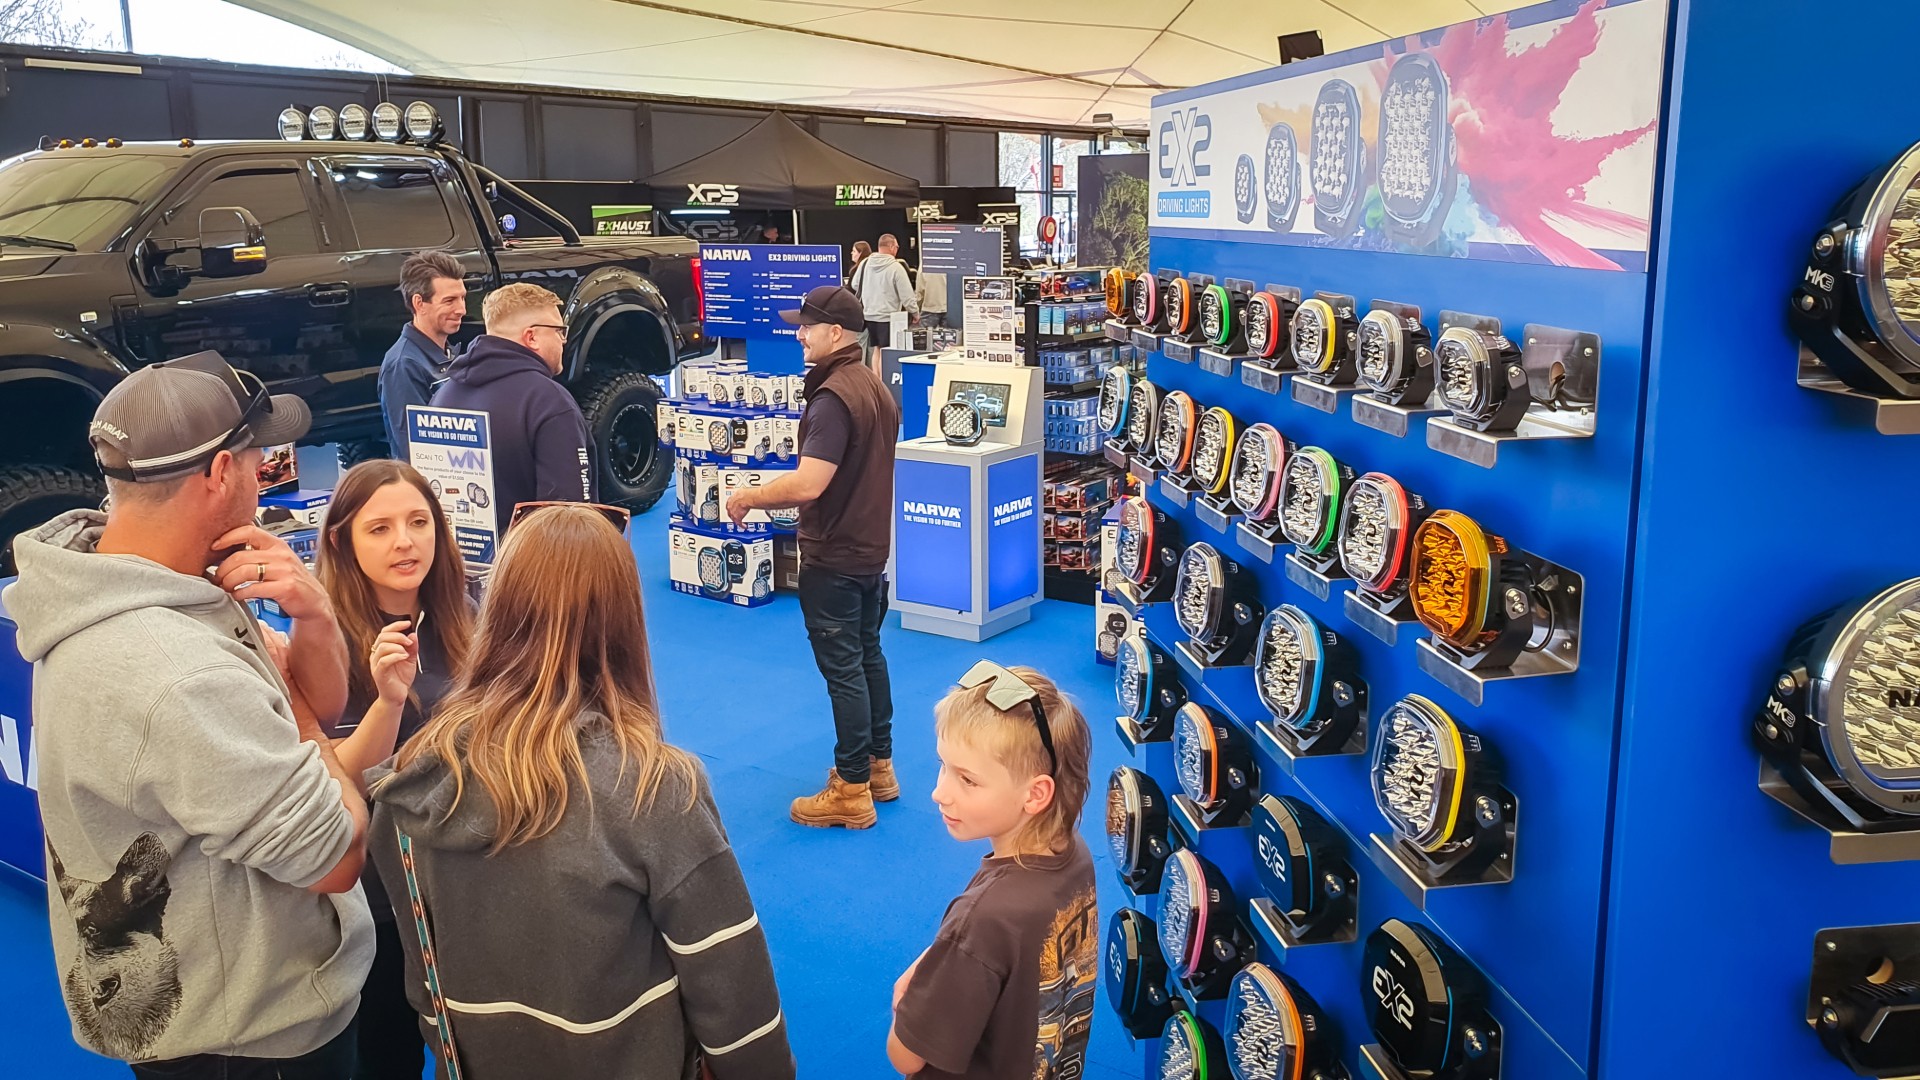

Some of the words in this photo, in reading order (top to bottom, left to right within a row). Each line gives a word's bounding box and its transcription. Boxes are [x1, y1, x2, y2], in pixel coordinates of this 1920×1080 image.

[1159, 107, 1211, 187] EX2
[687, 183, 740, 203] XPS
[835, 184, 886, 200] EXHAUST
[1158, 198, 1183, 213] DRIVING
[1184, 197, 1209, 213] LIGHTS
[596, 220, 652, 231] EXHAUST
[982, 212, 1018, 225] XPS
[702, 249, 752, 261] NARVA
[768, 253, 782, 262] EX2
[782, 254, 810, 262] DRIVING
[811, 254, 837, 263] LIGHTS
[1804, 265, 1835, 292] MK3
[101, 421, 129, 441] ARIAT
[416, 413, 477, 432] NARVA
[418, 430, 427, 438] THE
[427, 430, 443, 439] VISION
[443, 431, 450, 440] TO
[450, 432, 457, 440] GO
[457, 433, 478, 442] FURTHER
[416, 452, 433, 461] SCAN
[434, 454, 444, 462] TO
[447, 449, 486, 472] WIN
[577, 447, 589, 465] THE
[580, 468, 591, 500] VISION
[725, 471, 761, 488] EX2
[903, 500, 961, 519] NARVA
[993, 496, 1033, 518] NARVA
[904, 514, 913, 522] THE
[913, 516, 928, 524] VISION
[928, 517, 935, 525] TO
[935, 518, 941, 526] GO
[941, 519, 962, 529] FURTHER
[1001, 516, 1011, 525] VISION
[1020, 509, 1033, 519] FURTHER
[1766, 694, 1796, 728] MK3
[1258, 833, 1286, 883] EX2
[1372, 965, 1415, 1031] EX2
